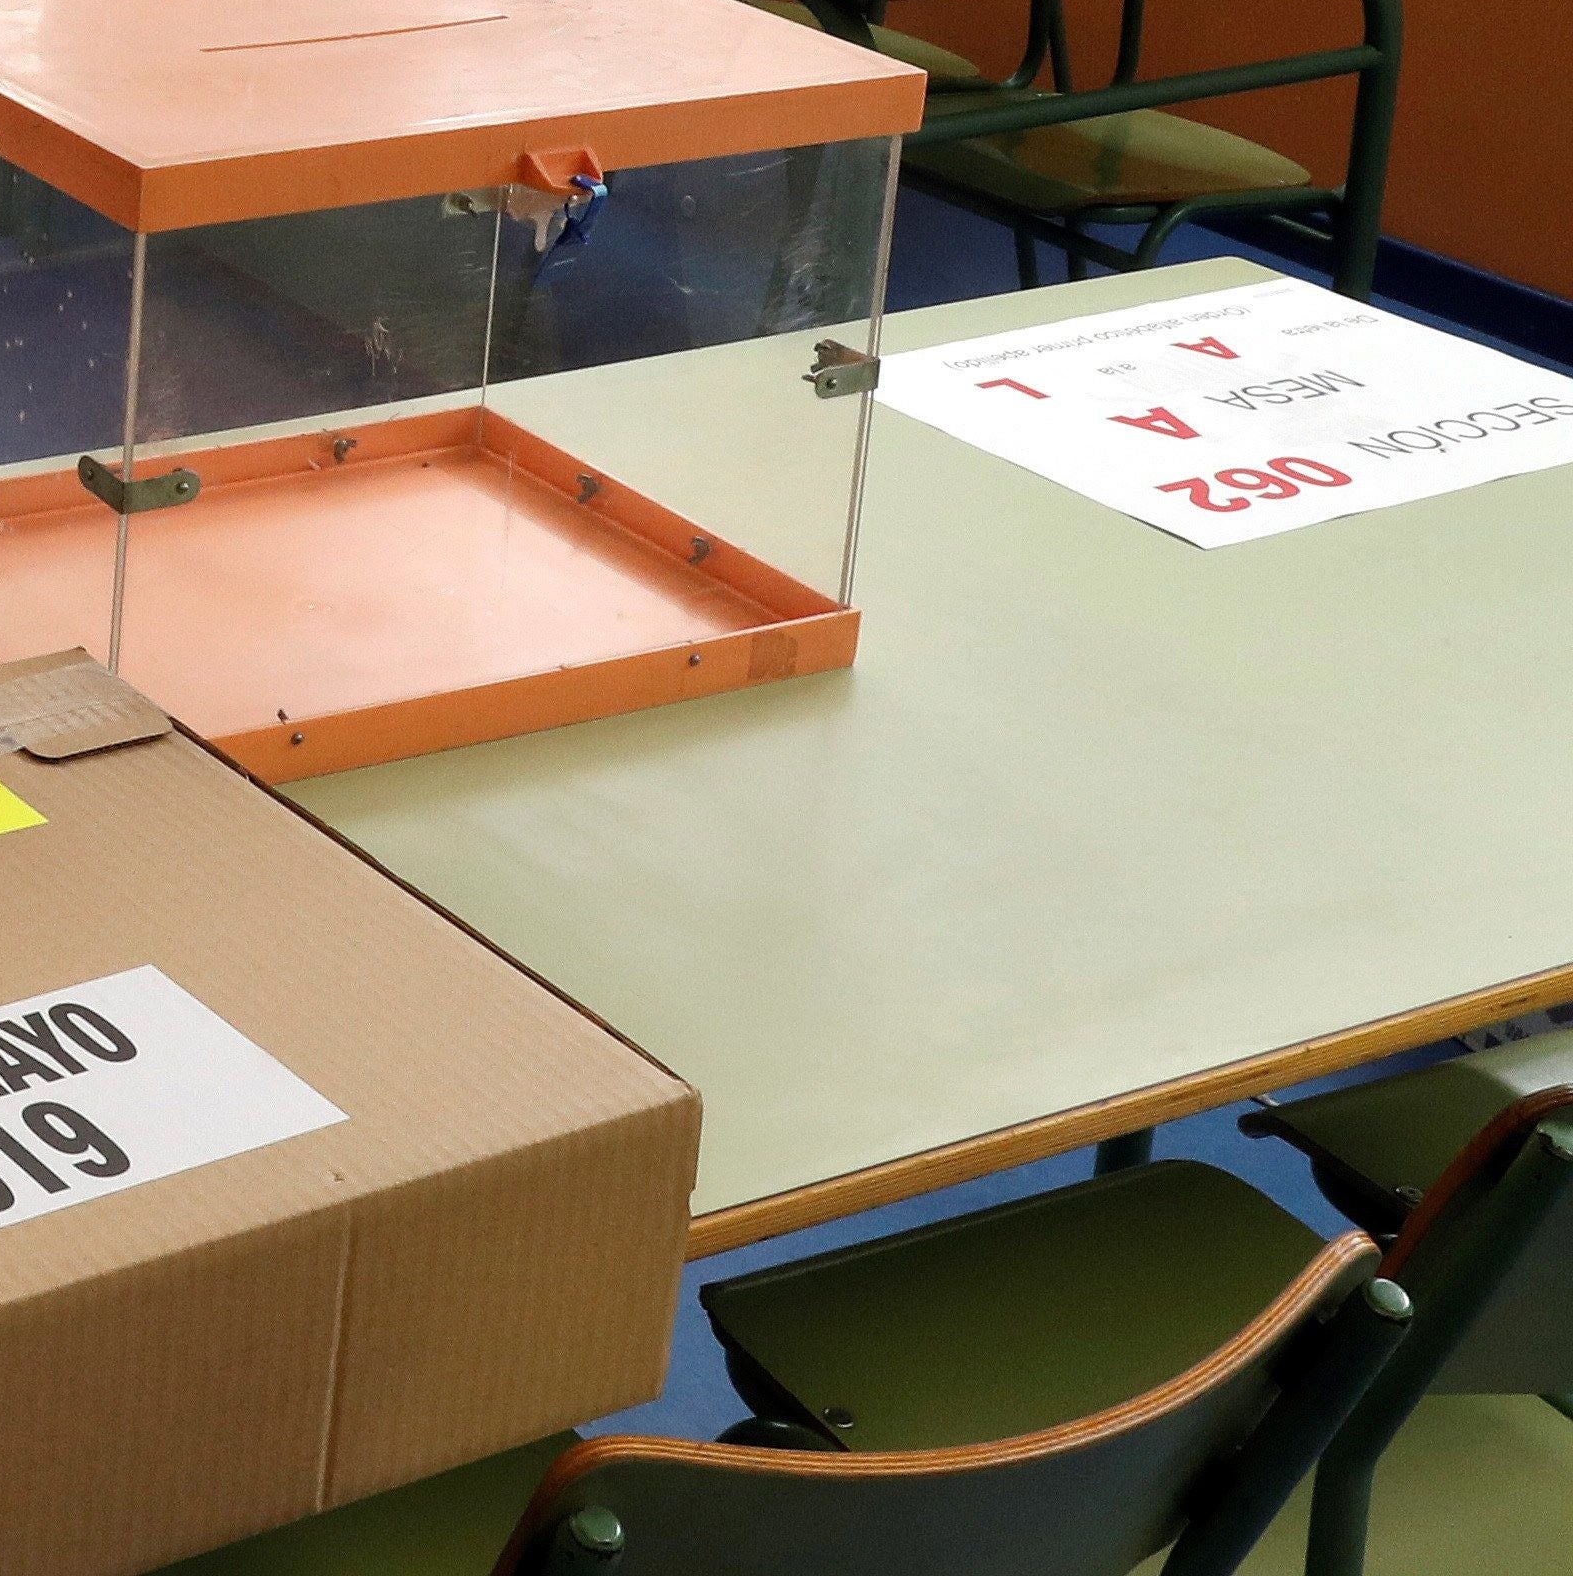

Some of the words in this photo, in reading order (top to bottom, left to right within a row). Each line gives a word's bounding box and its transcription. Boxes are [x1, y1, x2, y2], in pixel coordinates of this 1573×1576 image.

[1170, 336, 1241, 360] A
[973, 377, 1052, 399] L
[1203, 368, 1366, 412] MESA
[1107, 405, 1203, 440] A
[1347, 397, 1573, 459] SECCIÓN
[1154, 456, 1353, 512] 062
